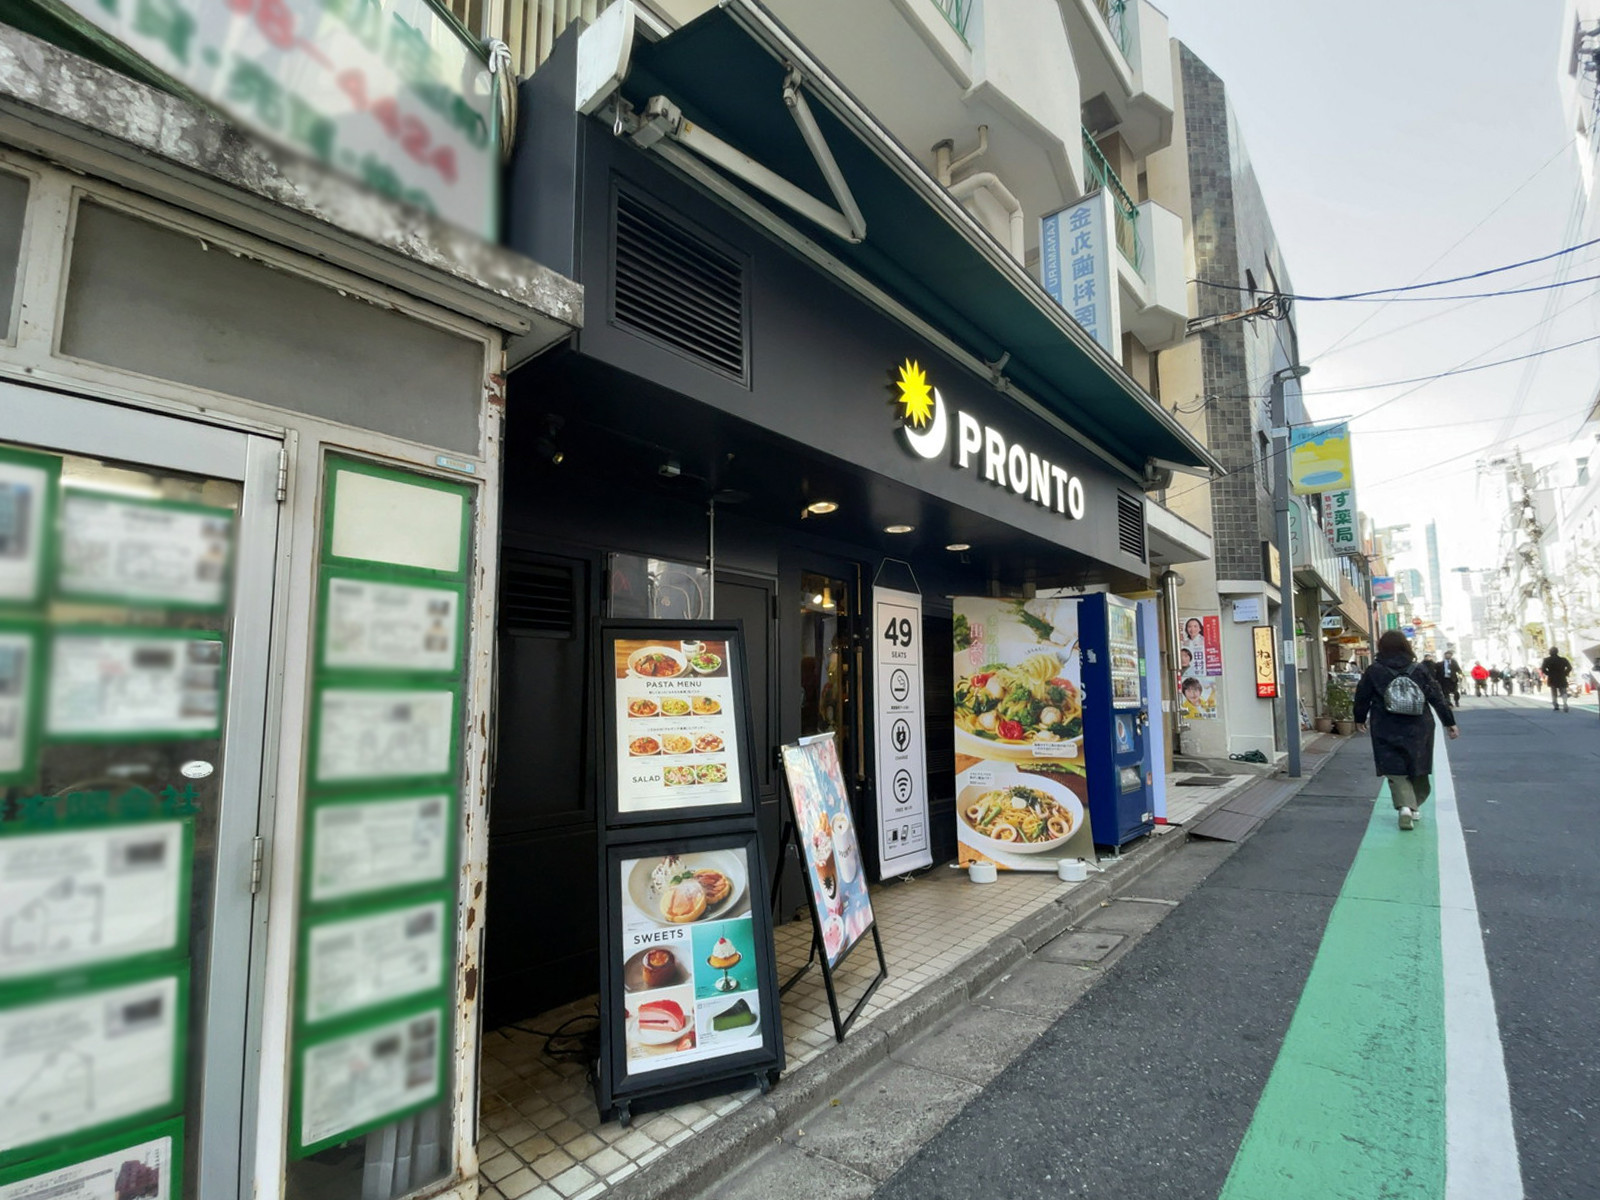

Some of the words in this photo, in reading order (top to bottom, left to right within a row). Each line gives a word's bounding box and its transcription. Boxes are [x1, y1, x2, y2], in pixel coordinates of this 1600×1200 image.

[958, 410, 1085, 521] PRONTO
[884, 616, 913, 648] 49
[891, 650, 908, 659] SEATS
[677, 680, 702, 688] MENU
[1258, 685, 1275, 695] 2F
[632, 775, 661, 784] SALAD
[633, 928, 684, 945] SWEETS
